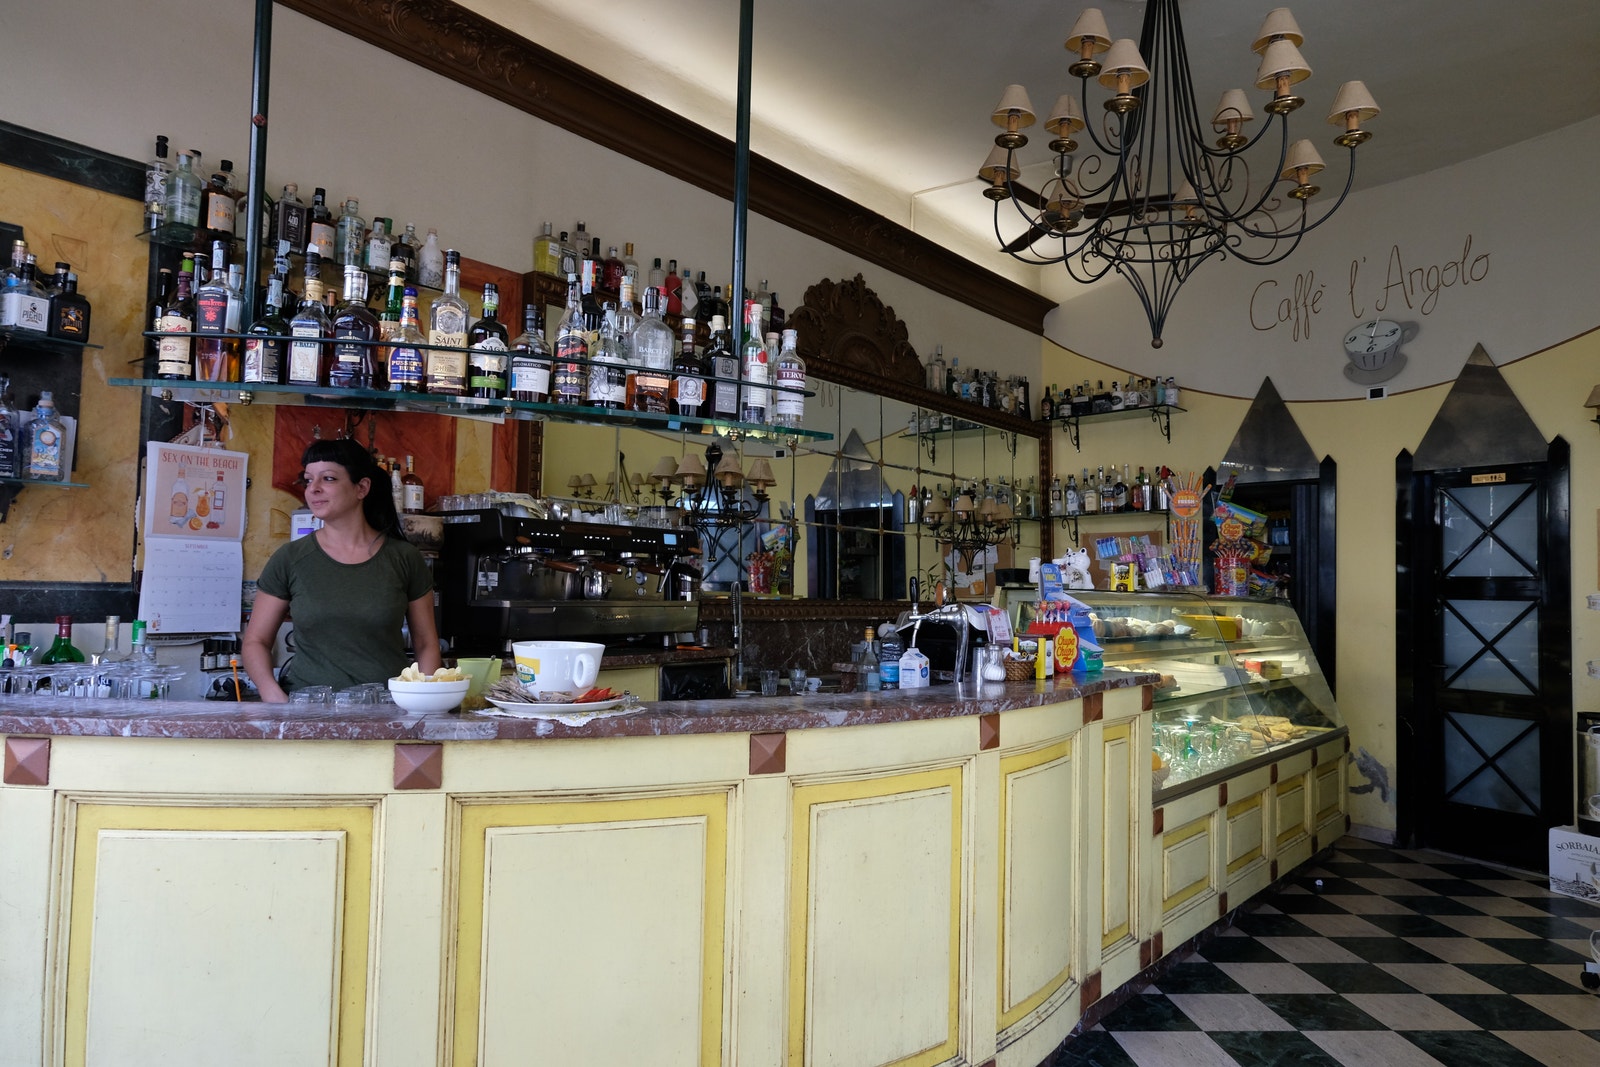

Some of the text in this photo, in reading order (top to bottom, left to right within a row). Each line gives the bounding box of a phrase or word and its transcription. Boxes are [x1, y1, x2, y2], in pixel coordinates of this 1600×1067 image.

[1250, 270, 1327, 342] Caffè
[435, 335, 462, 346] SAINT
[1345, 328, 1399, 345] 9 3
[1366, 343, 1377, 353] 6
[162, 452, 238, 470] SEX ON THE BEACH
[1057, 636, 1076, 650] Chupa
[1056, 645, 1076, 657] Chups
